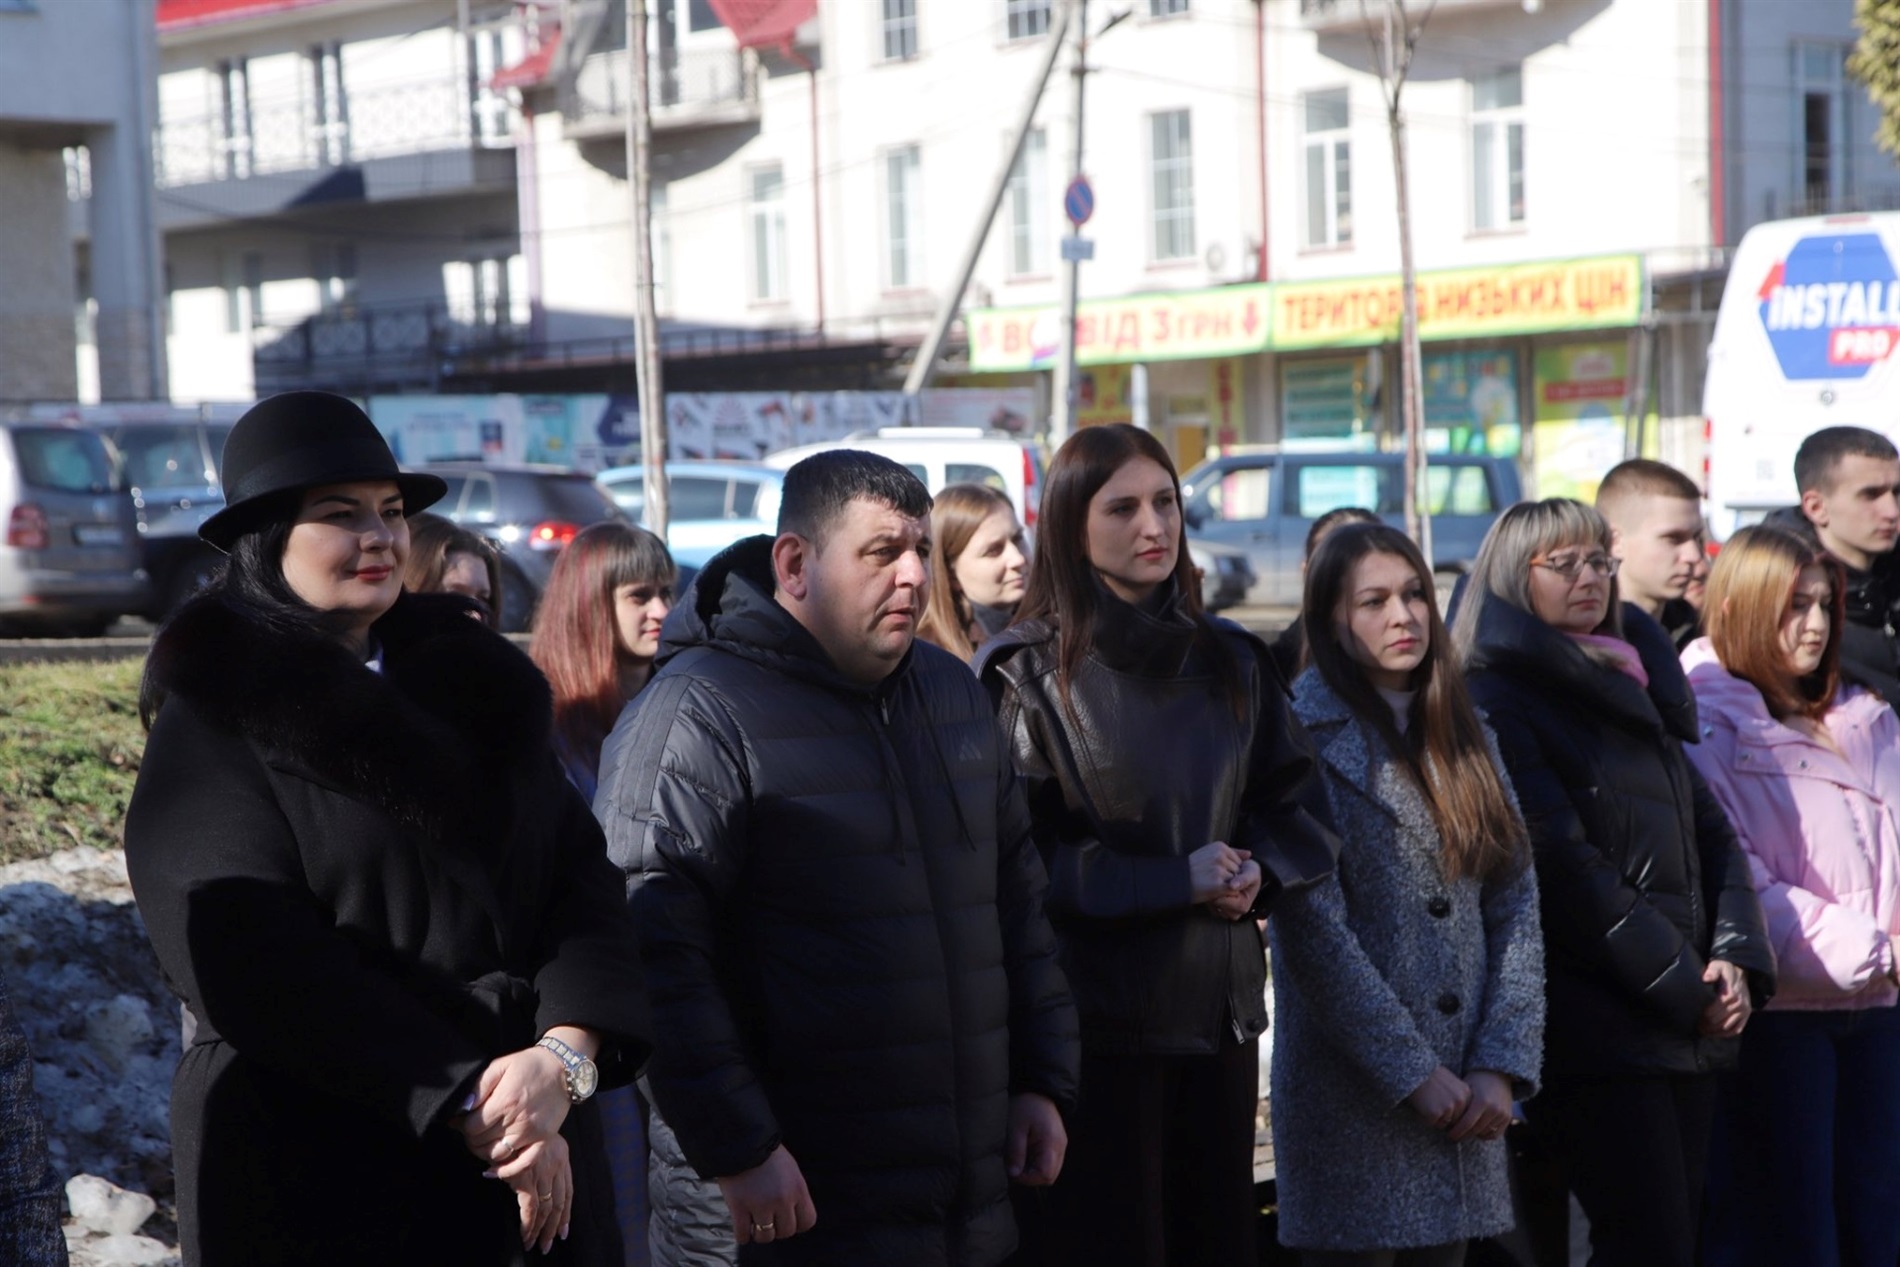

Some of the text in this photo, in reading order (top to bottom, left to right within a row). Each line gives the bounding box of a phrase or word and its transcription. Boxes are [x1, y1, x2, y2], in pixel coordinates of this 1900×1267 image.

[1284, 267, 1628, 332] ТЕРИТОРЯ НИЗЬКИХ ЦІН
[1834, 330, 1889, 359] PRO
